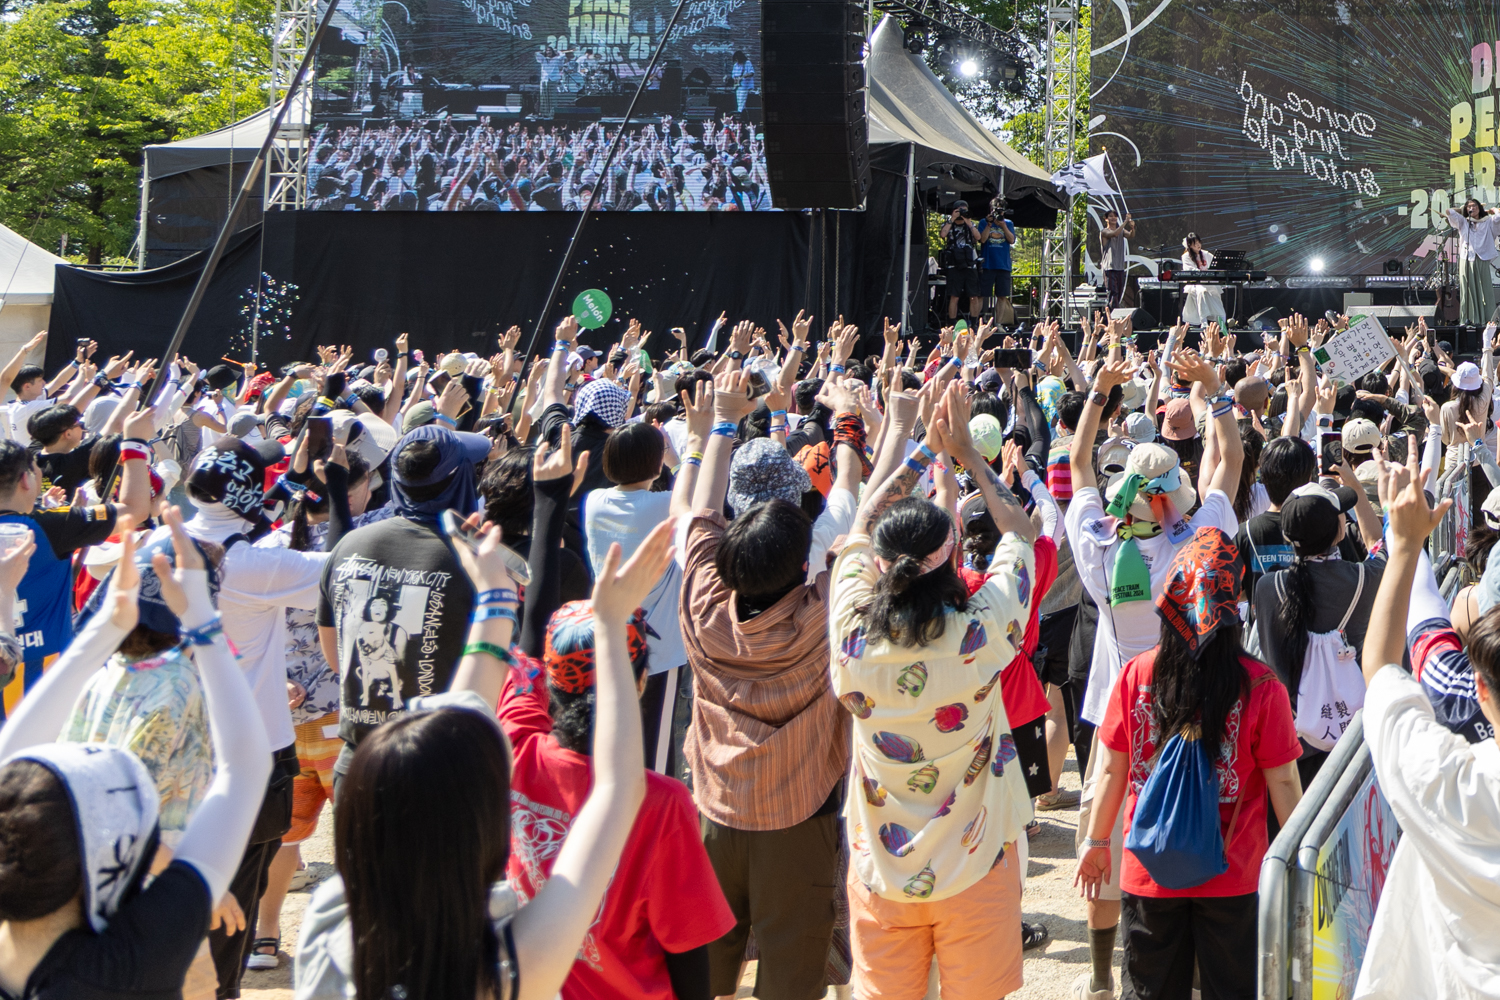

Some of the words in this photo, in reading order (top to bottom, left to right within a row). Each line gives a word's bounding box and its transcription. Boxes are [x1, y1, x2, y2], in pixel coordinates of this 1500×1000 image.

[568, 14, 630, 44] TRAIN
[1258, 554, 1277, 562] TEEN
[384, 566, 401, 582] NEW
[426, 569, 452, 587] CITY
[1126, 583, 1140, 592] TRAIN
